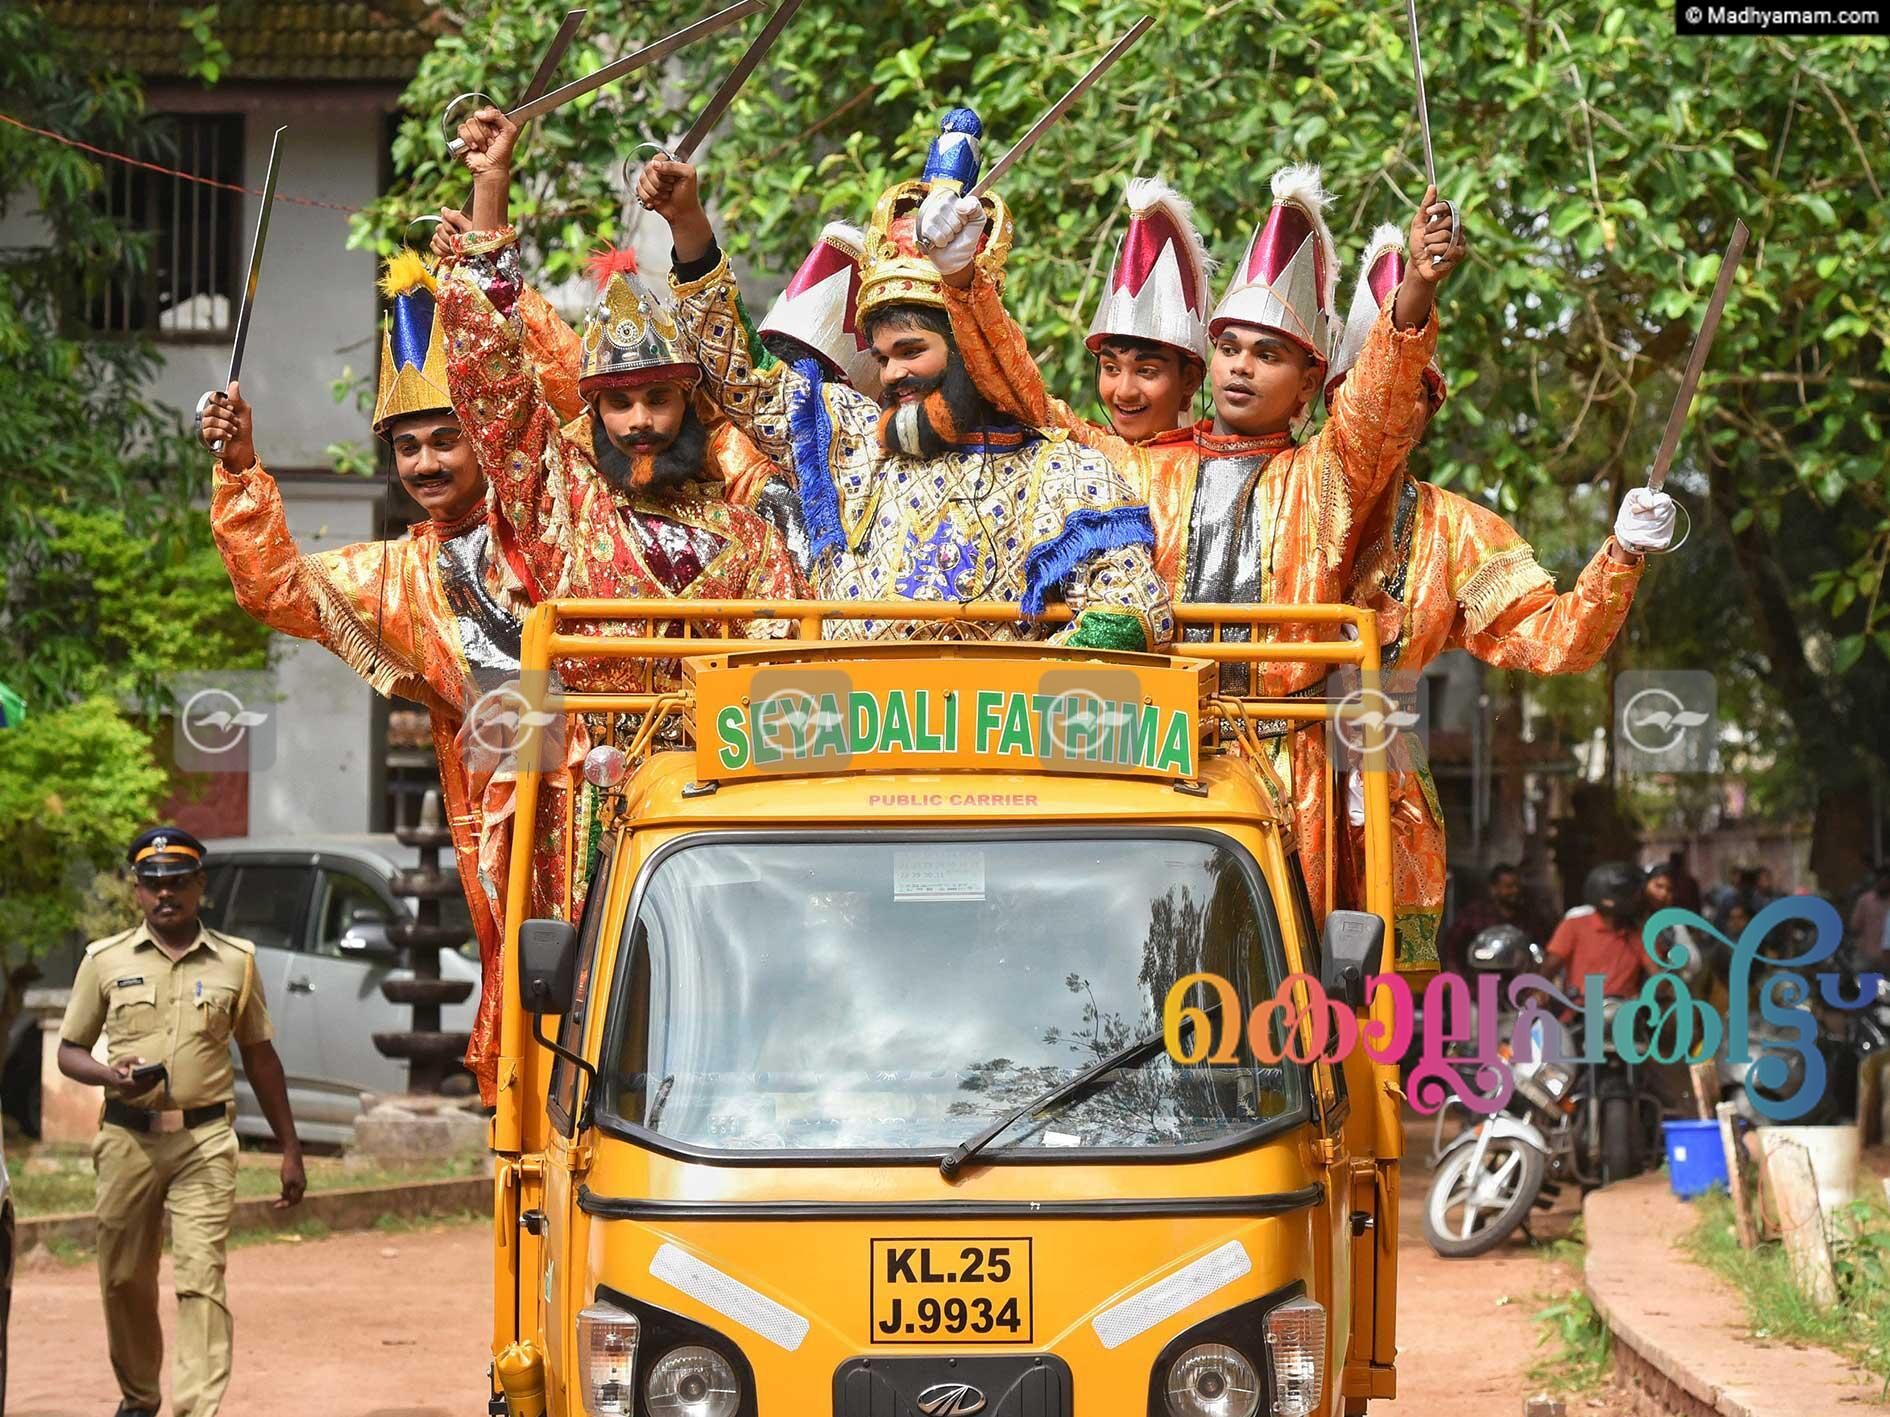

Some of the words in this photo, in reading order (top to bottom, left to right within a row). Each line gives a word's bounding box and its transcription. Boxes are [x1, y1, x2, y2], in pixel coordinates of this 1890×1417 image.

[715, 689, 959, 771] SEYADALI
[975, 690, 1194, 777] FATHIMA
[868, 794, 943, 807] PUBLIC
[949, 794, 1038, 807] CARRIER
[887, 1247, 1012, 1284] KL.25
[878, 1297, 1021, 1335] J.9934
